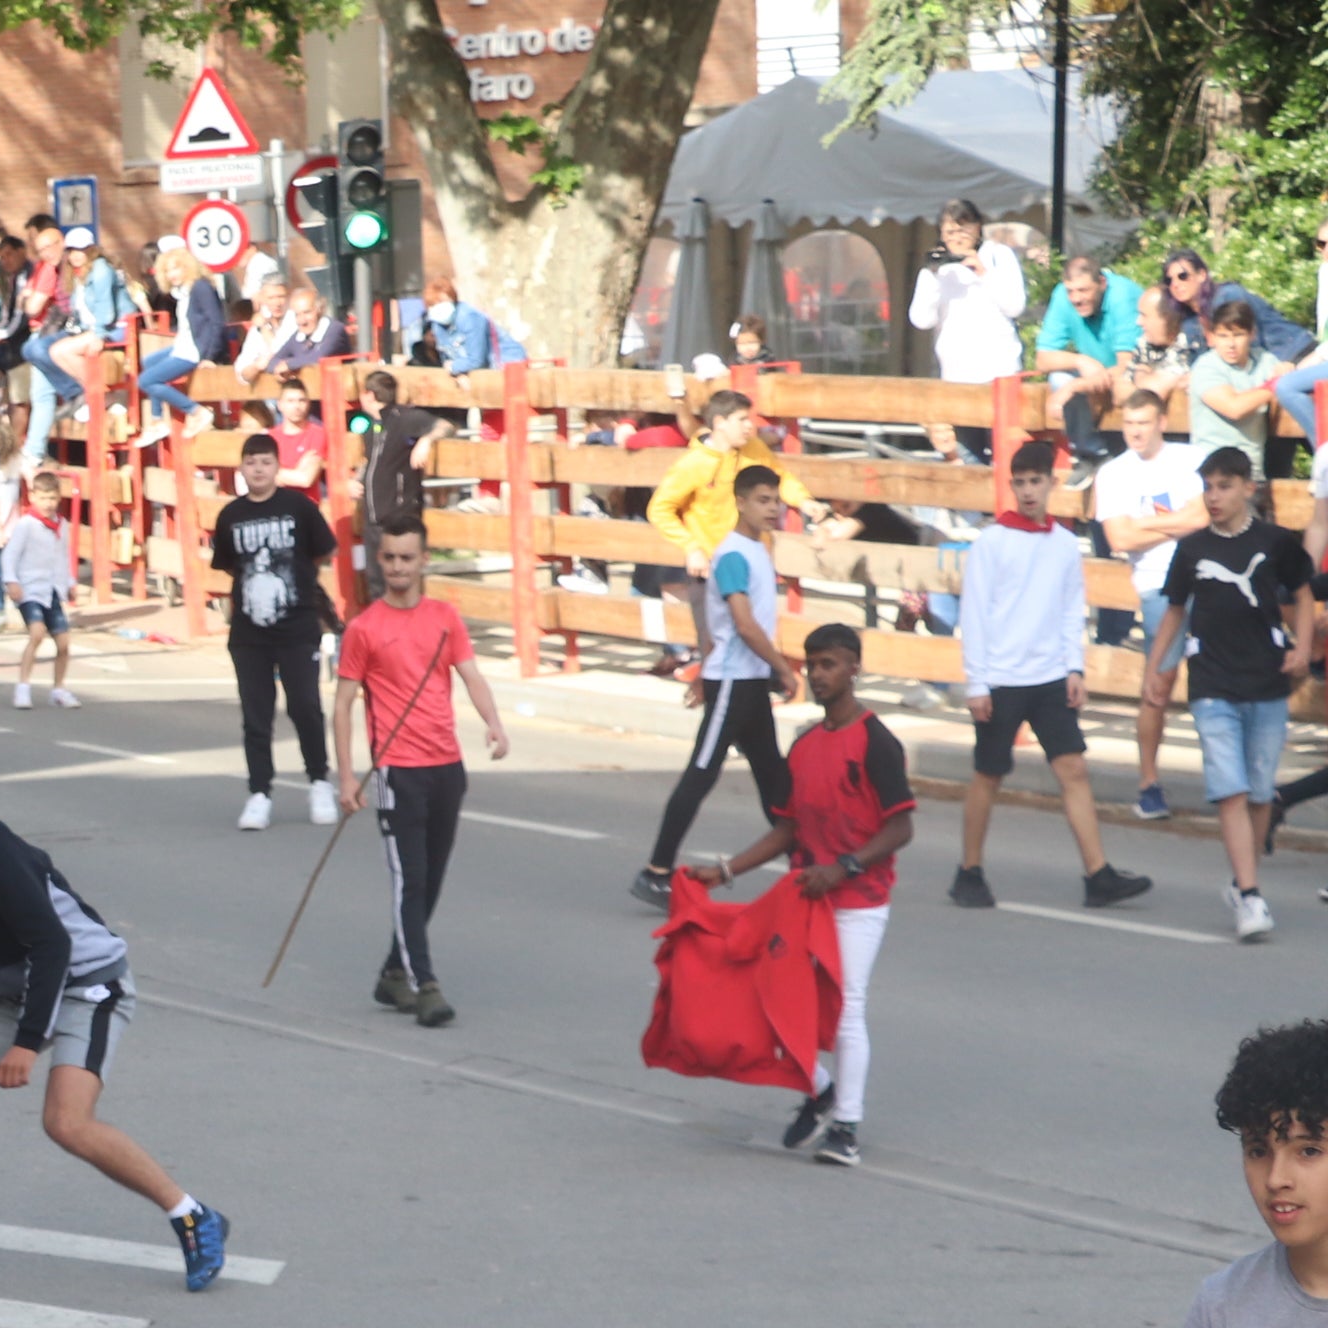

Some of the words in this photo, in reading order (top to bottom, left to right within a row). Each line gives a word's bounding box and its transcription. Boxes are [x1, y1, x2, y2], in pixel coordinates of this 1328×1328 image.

[548, 18, 595, 53] de
[197, 224, 233, 248] 30
[231, 514, 296, 554] TUPAC
